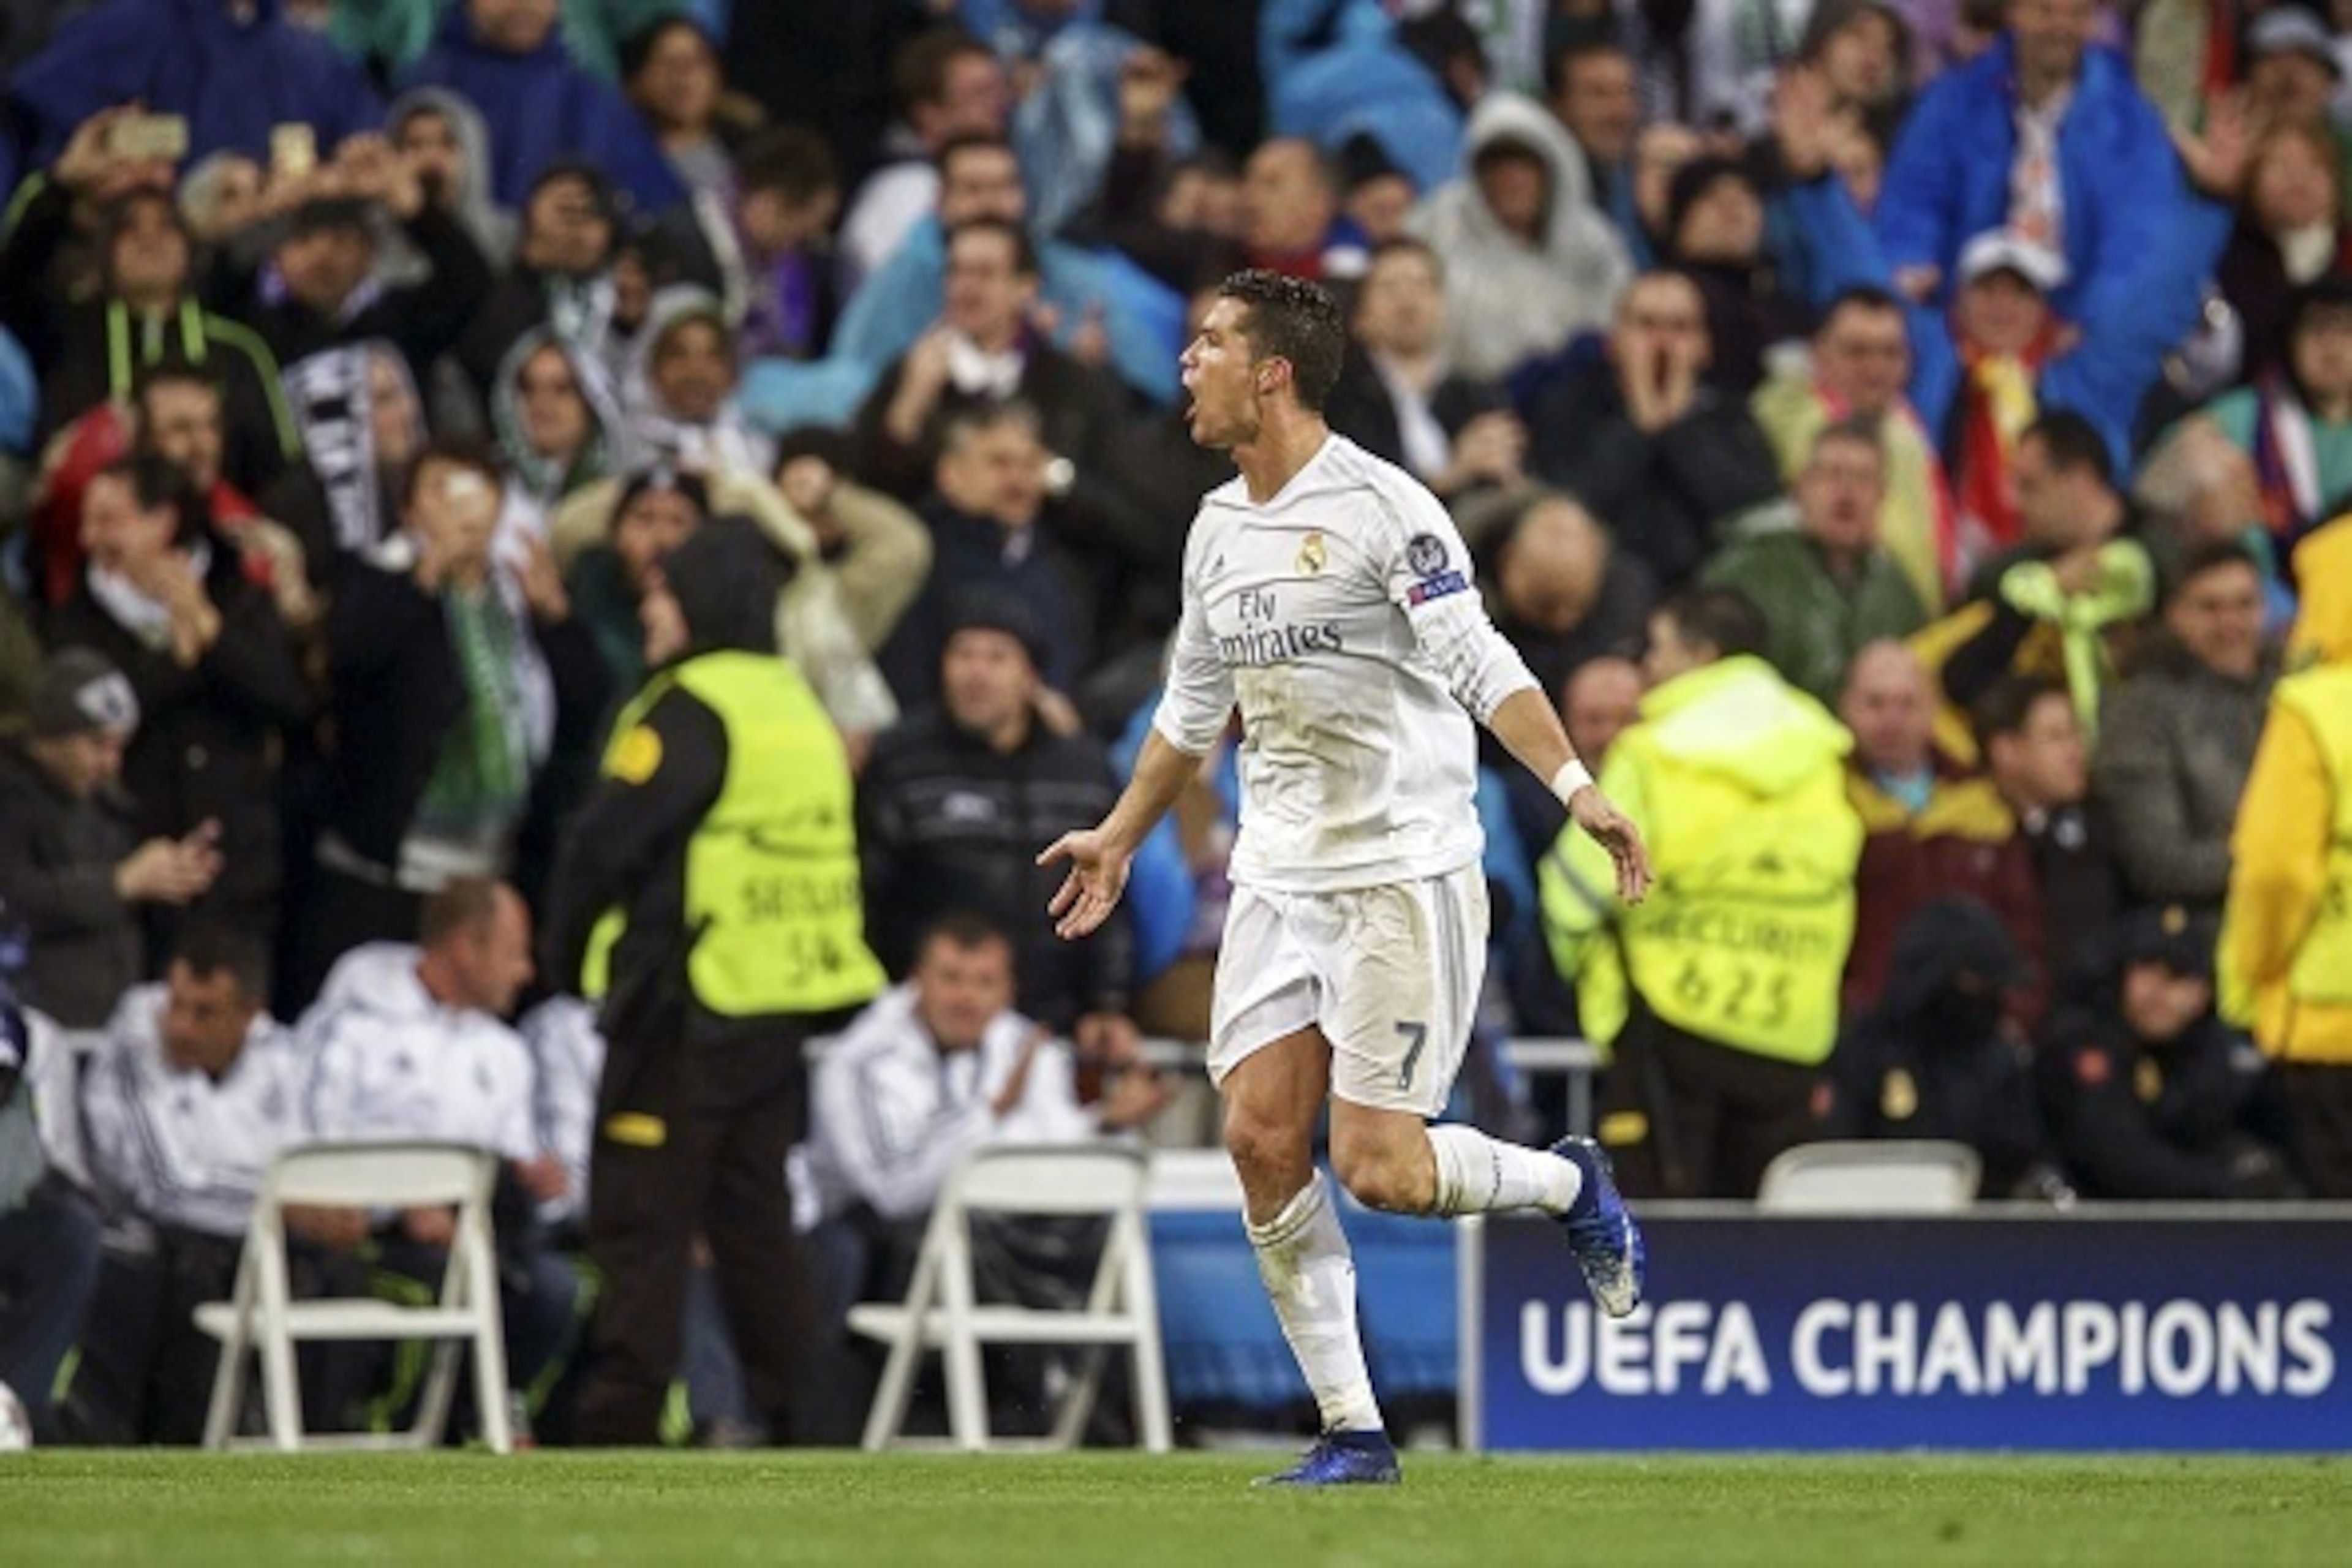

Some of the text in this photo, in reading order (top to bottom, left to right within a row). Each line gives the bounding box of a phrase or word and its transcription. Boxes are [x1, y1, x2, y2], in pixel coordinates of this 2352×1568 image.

[1238, 592, 1276, 621] Fly
[1216, 622, 1341, 665] mirates
[1394, 1021, 1426, 1091] 7
[1520, 1298, 2335, 1397] UEFA CHAMPIONS
